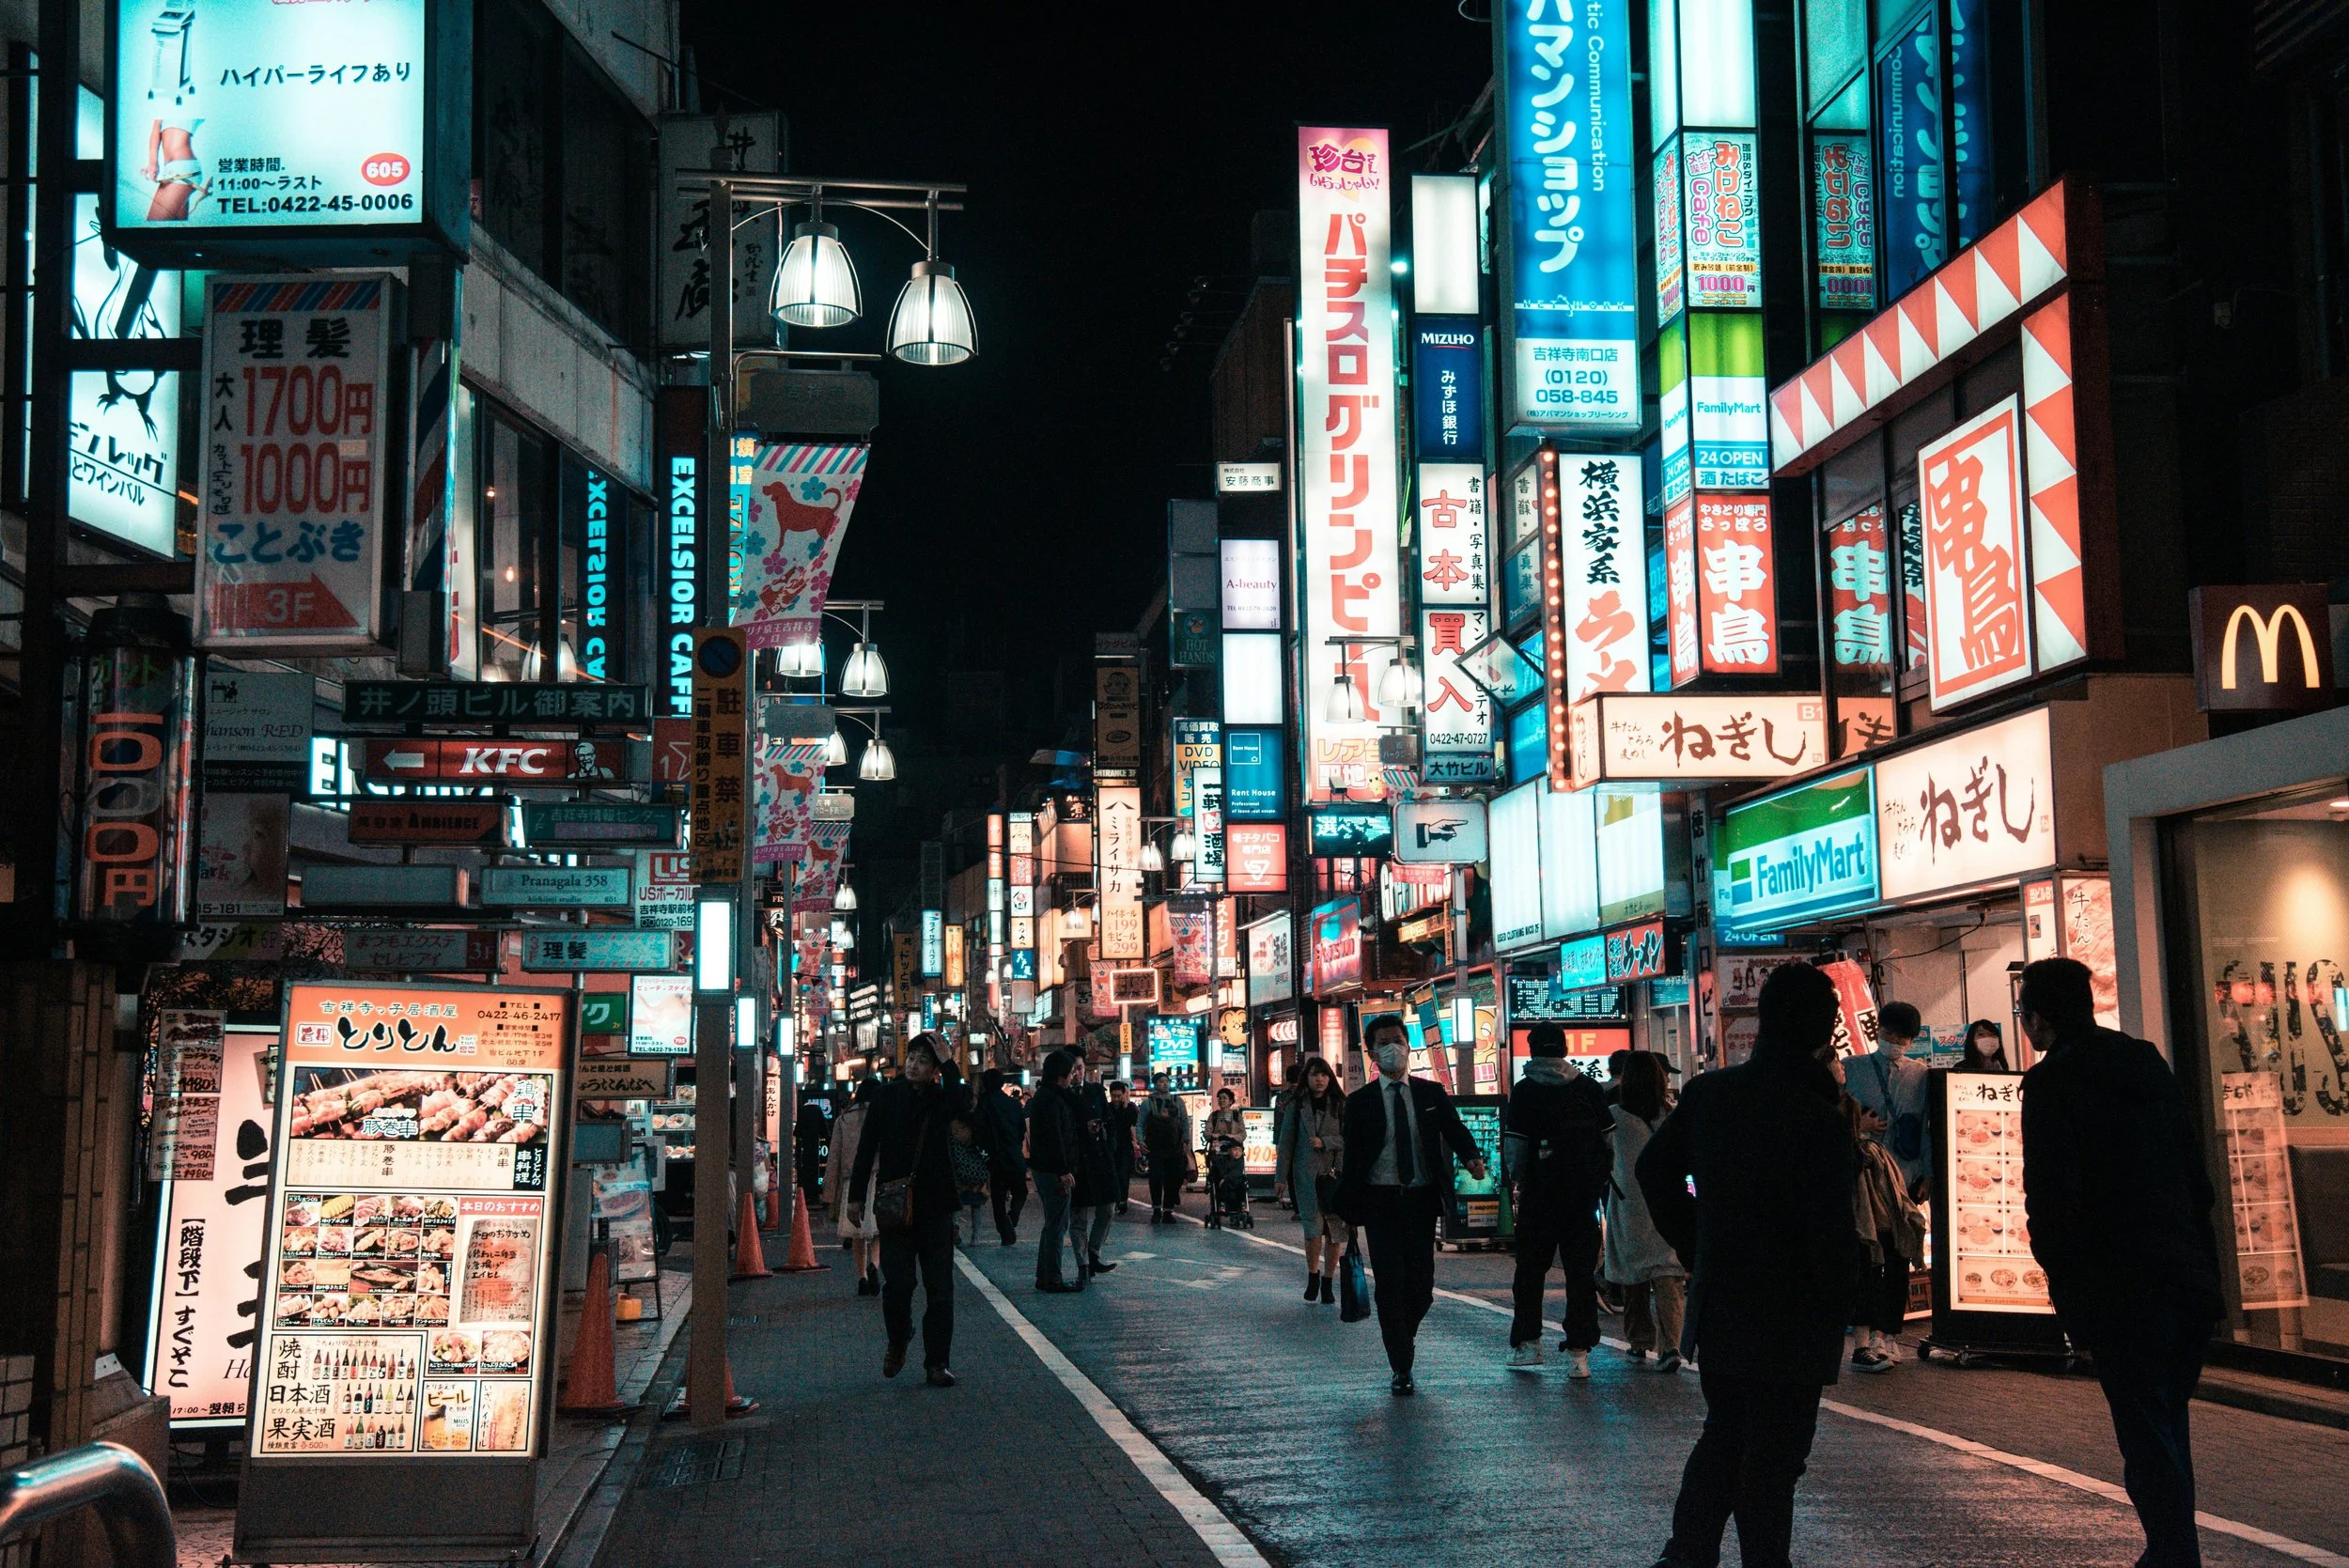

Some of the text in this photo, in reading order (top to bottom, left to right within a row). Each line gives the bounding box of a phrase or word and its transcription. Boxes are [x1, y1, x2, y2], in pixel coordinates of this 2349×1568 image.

[220, 62, 412, 87] ハイパーライフあり
[1587, 35, 1608, 193] Communication
[366, 161, 404, 179] 605
[217, 194, 413, 214] TEL:0422-45-0006
[1714, 141, 1744, 248] みけねこ
[1696, 274, 1755, 293] 1000円
[239, 318, 351, 359] 理髪
[1421, 333, 1474, 345] MIZUHO
[1532, 346, 1619, 363] 吉祥寺南口店
[1545, 369, 1609, 386] (0120)
[214, 373, 235, 432] 大人
[241, 365, 374, 436] 1700円
[1440, 369, 1457, 445] みずほ銀行
[1535, 388, 1619, 404] 058-845
[1697, 400, 1762, 415] FamilyMart
[1699, 450, 1764, 465] 24 OPEN
[241, 442, 370, 515] 1000円
[1225, 474, 1274, 487] 安藤商事
[1700, 471, 1764, 487] 酒 たばこ
[1579, 459, 1622, 586] 横浜家系
[1700, 504, 1766, 518] やきとり専門
[1699, 517, 1767, 533] さっぽろ
[214, 521, 365, 564] ことぶき
[1421, 489, 1470, 592] 古本
[1931, 453, 2018, 673] 串鳥
[671, 457, 695, 718] EXCELSIOR CAFF
[1225, 578, 1278, 591] A-beauty
[264, 589, 316, 623] 3F
[1704, 539, 1770, 666] 串鳥
[1427, 612, 1474, 714] 買入
[360, 688, 635, 719] 井ノ頭ビル御案内
[1429, 733, 1488, 746] 0422-47-0727
[1659, 709, 1808, 768] ねぎし
[459, 748, 548, 774] KFC
[1184, 746, 1213, 757] DVD
[1430, 762, 1489, 777] 大竹ビル
[1231, 788, 1276, 797] Rent House
[1920, 754, 2035, 867] ねぎし
[1108, 815, 1122, 893] ミライザカ
[1756, 831, 1866, 899] FamilyMart
[521, 874, 608, 891] Pranagala 358
[657, 916, 694, 927] 0120-169
[542, 940, 588, 960] 理髪
[477, 1010, 561, 1021] 0422-46-2417
[337, 1017, 457, 1053] とりとん
[514, 1149, 532, 1185] 串料理
[460, 1202, 540, 1213] 本日のおすすめ
[276, 1337, 303, 1381] 焼酎
[269, 1382, 331, 1406] 日本酒
[428, 1389, 472, 1407] ビール
[267, 1416, 336, 1441] 果実酒
